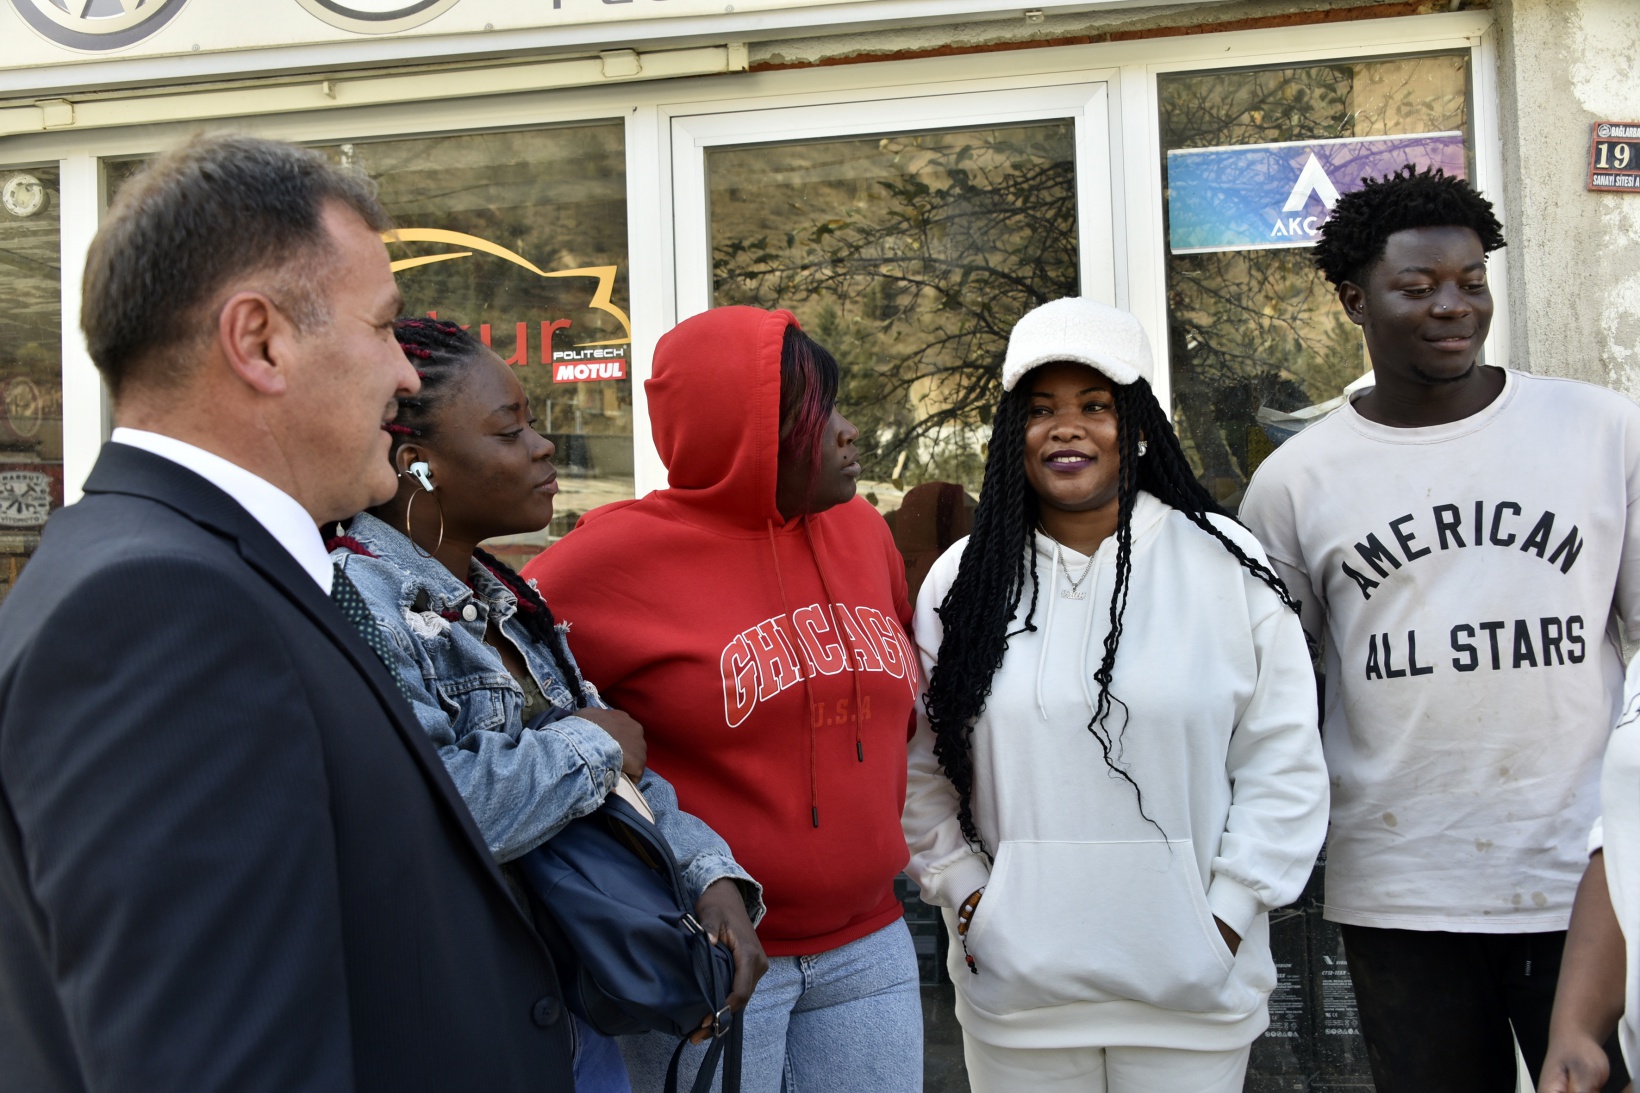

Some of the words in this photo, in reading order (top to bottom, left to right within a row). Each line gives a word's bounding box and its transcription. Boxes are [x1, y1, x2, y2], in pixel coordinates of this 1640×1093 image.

[1596, 143, 1630, 169] 19
[1593, 174, 1615, 186] SANAYİ
[1615, 174, 1634, 187] SİTESİ
[553, 348, 624, 361] POLITECH
[556, 362, 623, 381] MOTUL
[1341, 500, 1584, 601] AMERICAN
[1365, 629, 1434, 681] ALL
[1449, 614, 1586, 673] STARS
[720, 603, 919, 728] CHICAGO
